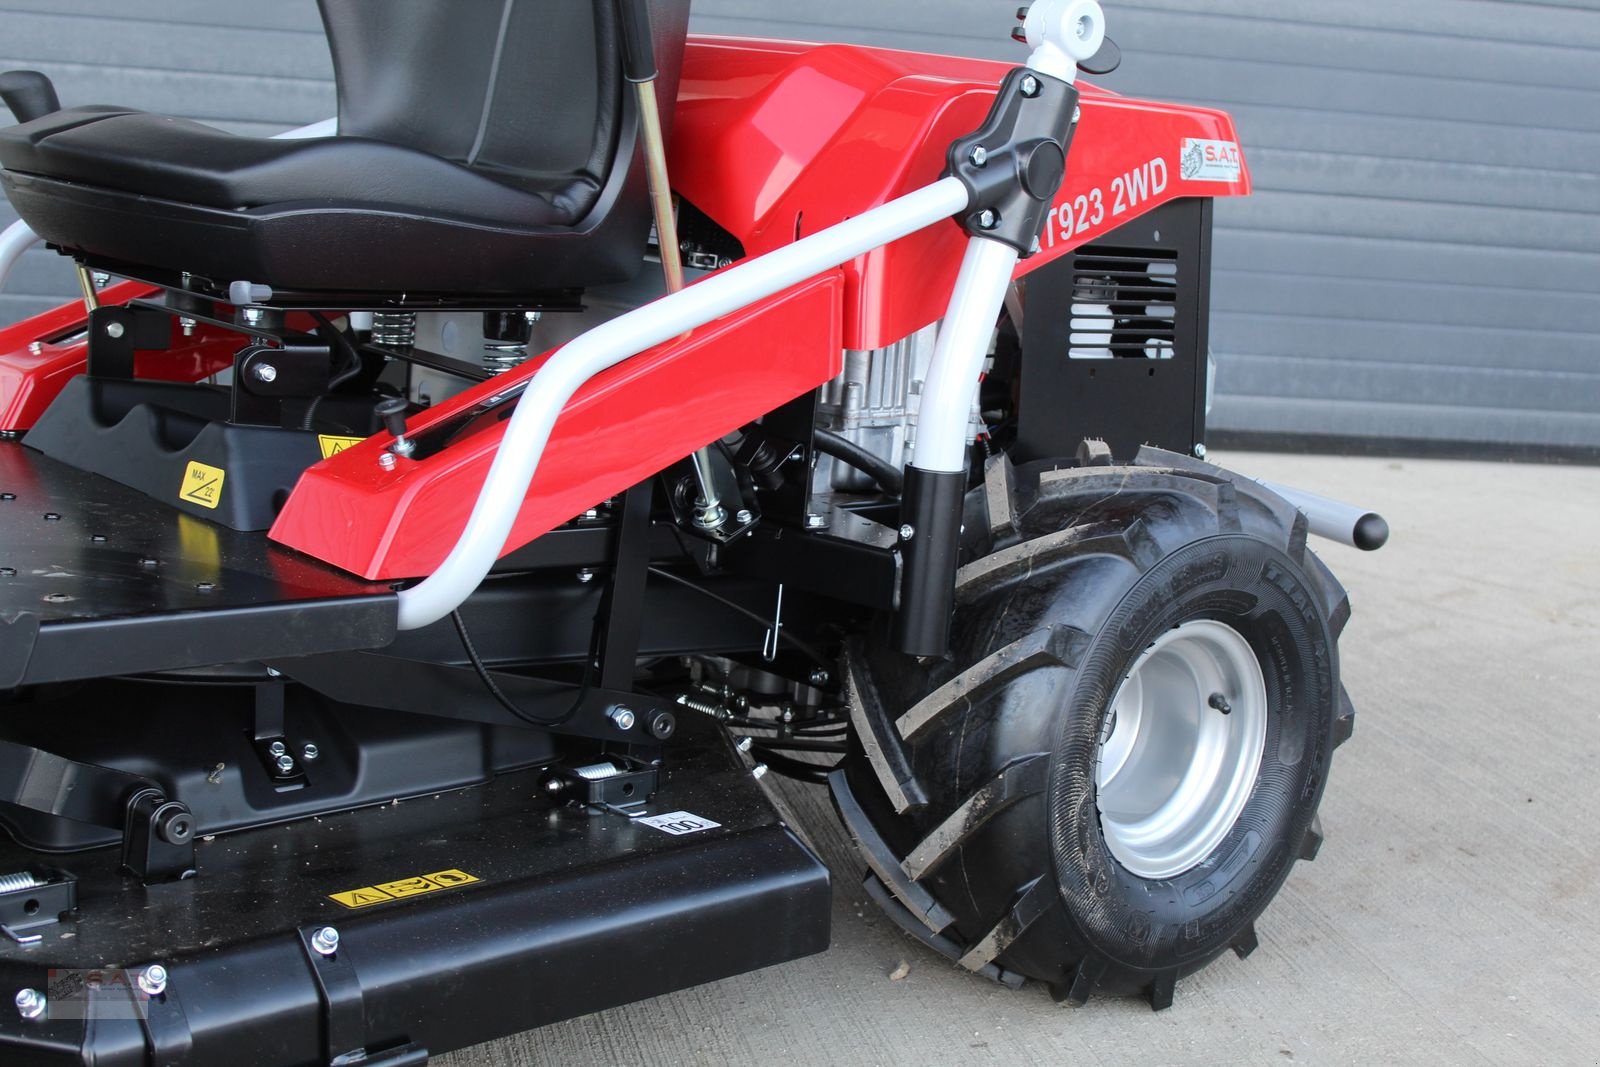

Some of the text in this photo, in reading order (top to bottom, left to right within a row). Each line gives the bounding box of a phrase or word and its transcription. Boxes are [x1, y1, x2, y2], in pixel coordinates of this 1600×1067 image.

[1111, 157, 1167, 216] 2WD
[192, 469, 206, 481] MAX
[660, 821, 703, 832] 100
